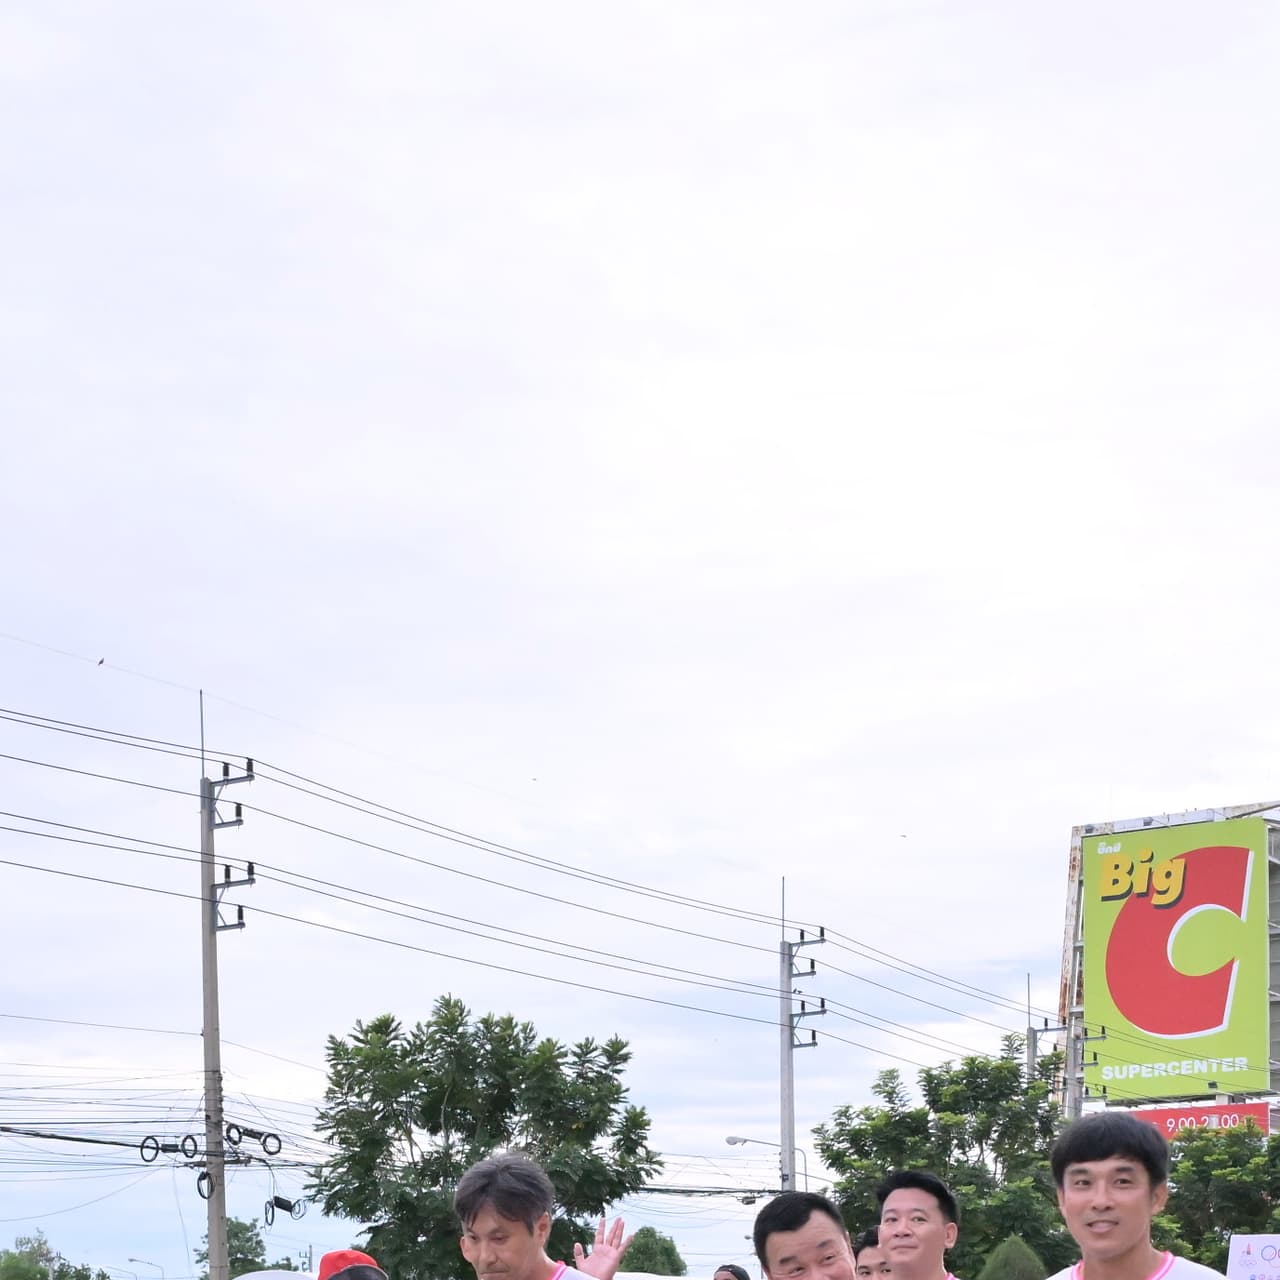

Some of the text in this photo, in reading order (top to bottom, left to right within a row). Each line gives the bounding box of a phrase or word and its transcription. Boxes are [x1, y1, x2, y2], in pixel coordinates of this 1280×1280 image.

[1100, 847, 1187, 910] Big
[1106, 846, 1254, 1040] C
[1101, 1056, 1248, 1080] SUPERCENTER
